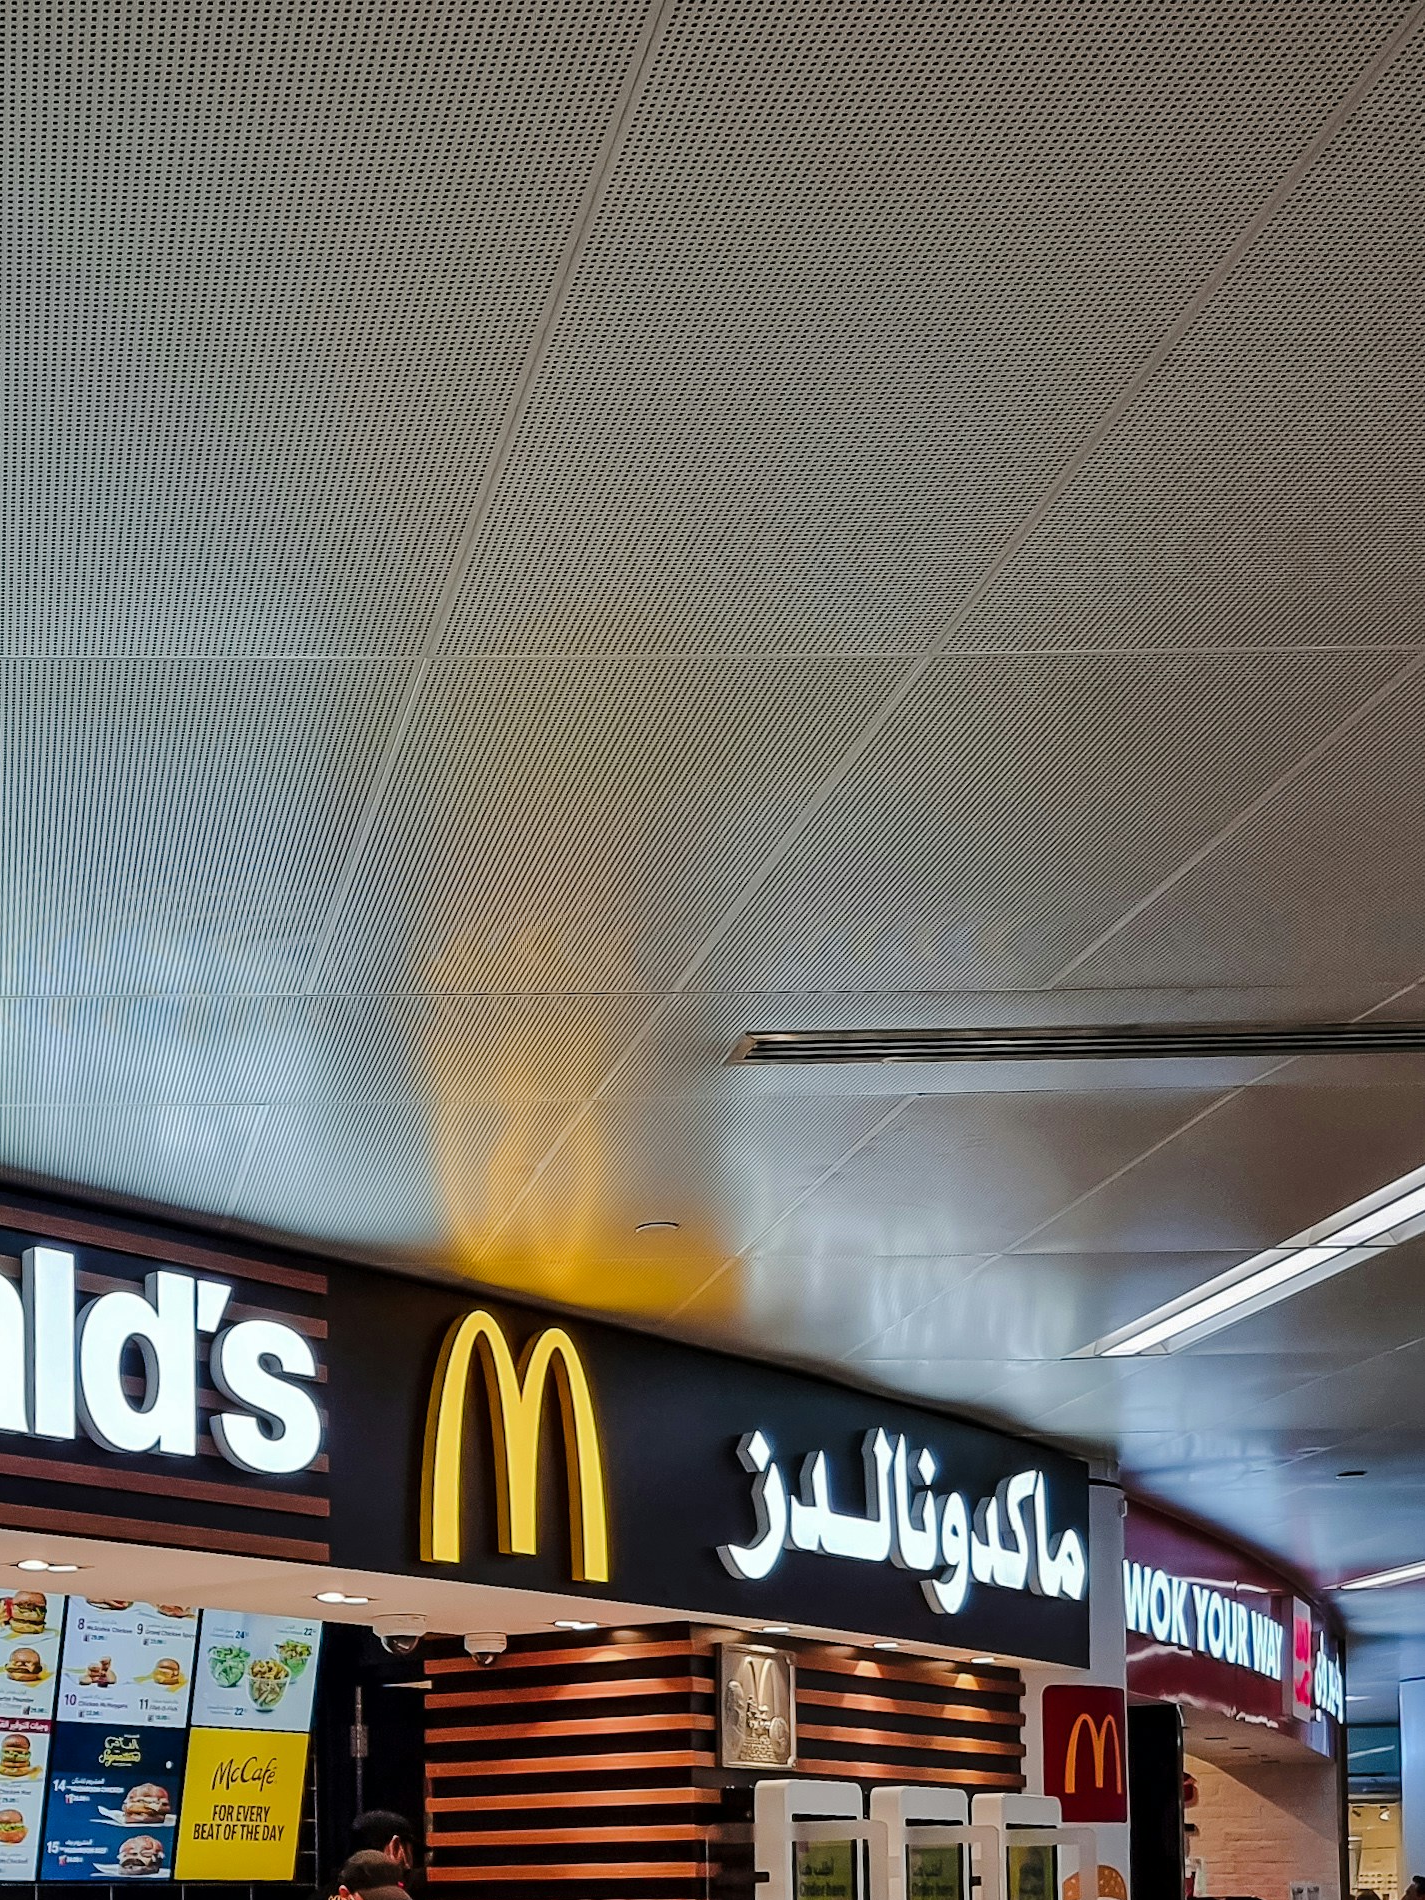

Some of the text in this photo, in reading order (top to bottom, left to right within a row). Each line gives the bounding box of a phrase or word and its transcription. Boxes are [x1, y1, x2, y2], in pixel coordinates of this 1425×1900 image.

[716, 1426, 1086, 1615] ماكدونالدز
[78, 1618, 85, 1630] 8
[1122, 1559, 1189, 1648] WOK
[1192, 1584, 1251, 1668] YOUR
[1251, 1609, 1284, 1681] WAY
[137, 1623, 144, 1635] 9
[235, 1630, 245, 1639] 24
[64, 1694, 76, 1706] 10
[139, 1698, 149, 1710] 11
[211, 1756, 277, 1792] McCafé
[53, 1779, 66, 1792] 14
[212, 1804, 271, 1822] FOR EVERY
[193, 1823, 285, 1841] BEAT OF THE DAY
[46, 1841, 60, 1854] 15
